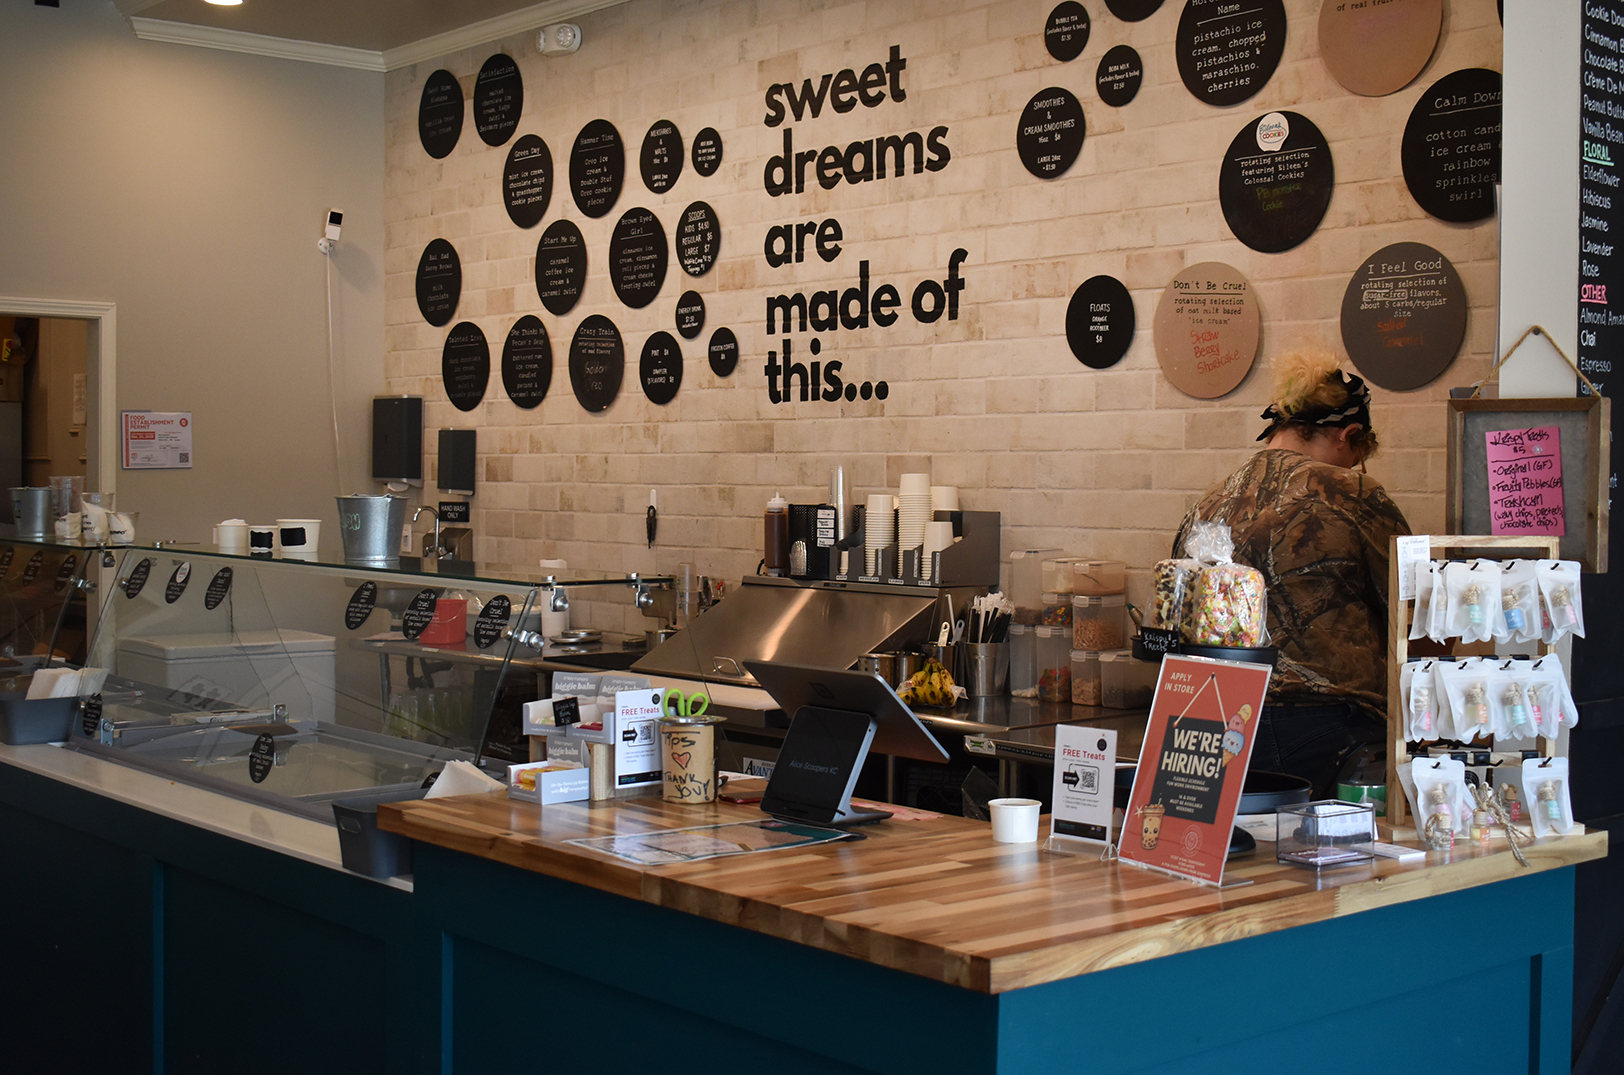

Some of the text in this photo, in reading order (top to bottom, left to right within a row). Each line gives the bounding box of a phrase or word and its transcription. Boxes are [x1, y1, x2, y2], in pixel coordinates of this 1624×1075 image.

[1217, 3, 1241, 15] Name
[1336, 3, 1346, 11] of
[1350, 1, 1367, 10] real
[1585, 1, 1610, 23] Cookie
[1055, 17, 1069, 25] BUBBLE
[1193, 19, 1263, 45] pistachio ice
[1584, 23, 1618, 53] Cinnamon
[1228, 32, 1267, 49] chopped
[1196, 51, 1250, 70] pistachios
[1584, 48, 1618, 72] Chocolate
[480, 66, 515, 79] Satisfaction
[1108, 62, 1130, 74] BOBA MILK
[764, 44, 907, 128] sweet
[1207, 77, 1251, 93] cherries
[1033, 97, 1066, 110] SMOOTHIES
[1434, 95, 1468, 109] Calm
[1583, 93, 1606, 115] Peanut
[1047, 111, 1053, 119] &
[1024, 118, 1076, 136] CREAM SMOOTHIES
[1425, 123, 1502, 142] cotton cand
[1582, 117, 1605, 139] Vanilla
[1262, 130, 1285, 140] COOKIES
[514, 147, 541, 158] Green Day
[1431, 142, 1491, 157] ice cream
[1583, 140, 1610, 160] FLORAL
[764, 126, 951, 198] dreams
[1037, 156, 1051, 164] LARGE
[1240, 152, 1310, 167] rotating selection
[1443, 157, 1491, 172] rainbow
[1241, 161, 1309, 177] featuring Eileen's
[1583, 164, 1620, 187] Elderflower
[1244, 171, 1305, 185] Colossal Cookies
[1435, 172, 1497, 190] sprinkles
[1449, 188, 1483, 202] swirl
[1582, 187, 1611, 210] Hibiscus
[621, 215, 653, 226] Brown Eyed
[688, 210, 706, 220] SCOOPS
[1581, 210, 1609, 232] Jasmine
[630, 228, 643, 236] Girl
[685, 224, 696, 233] KIDS
[544, 235, 577, 245] Start Me Up
[682, 234, 702, 246] REGULAR
[764, 217, 843, 268] are
[1581, 236, 1614, 257] Lavender
[685, 246, 699, 257] LARGE
[550, 257, 569, 266] caramel
[1368, 257, 1442, 275] I Feel Good
[1581, 259, 1600, 278] Rose
[545, 268, 562, 277] coffee
[766, 247, 969, 336] made of
[1173, 280, 1247, 292] Don't Be Cruel
[1361, 276, 1447, 292] rotating selection of
[1364, 291, 1407, 301] sugar-free
[1581, 283, 1607, 301] OTHER
[1090, 303, 1111, 313] FLOATS
[1174, 298, 1244, 308] rotating selection
[1360, 297, 1448, 310] about 5 carbs/regular
[1176, 306, 1242, 317] of oat milk based
[1393, 309, 1412, 318] size
[1580, 310, 1607, 327] Almond
[580, 327, 615, 336] Crazy Train
[1580, 332, 1597, 348] Chai
[764, 337, 889, 404] this...
[1580, 357, 1612, 374] Espresso
[447, 511, 459, 519] ONLY
[1170, 671, 1193, 682] APPLY
[554, 682, 596, 692] biggie balm
[1164, 681, 1196, 694] IN STORE
[621, 706, 661, 717] FREE Treats
[661, 731, 700, 750] Tips
[1173, 728, 1222, 755] WE'RE
[1062, 748, 1106, 761] FREE Treats
[789, 760, 839, 775] Alice Scoopers KC
[1161, 751, 1222, 779] HIRING!
